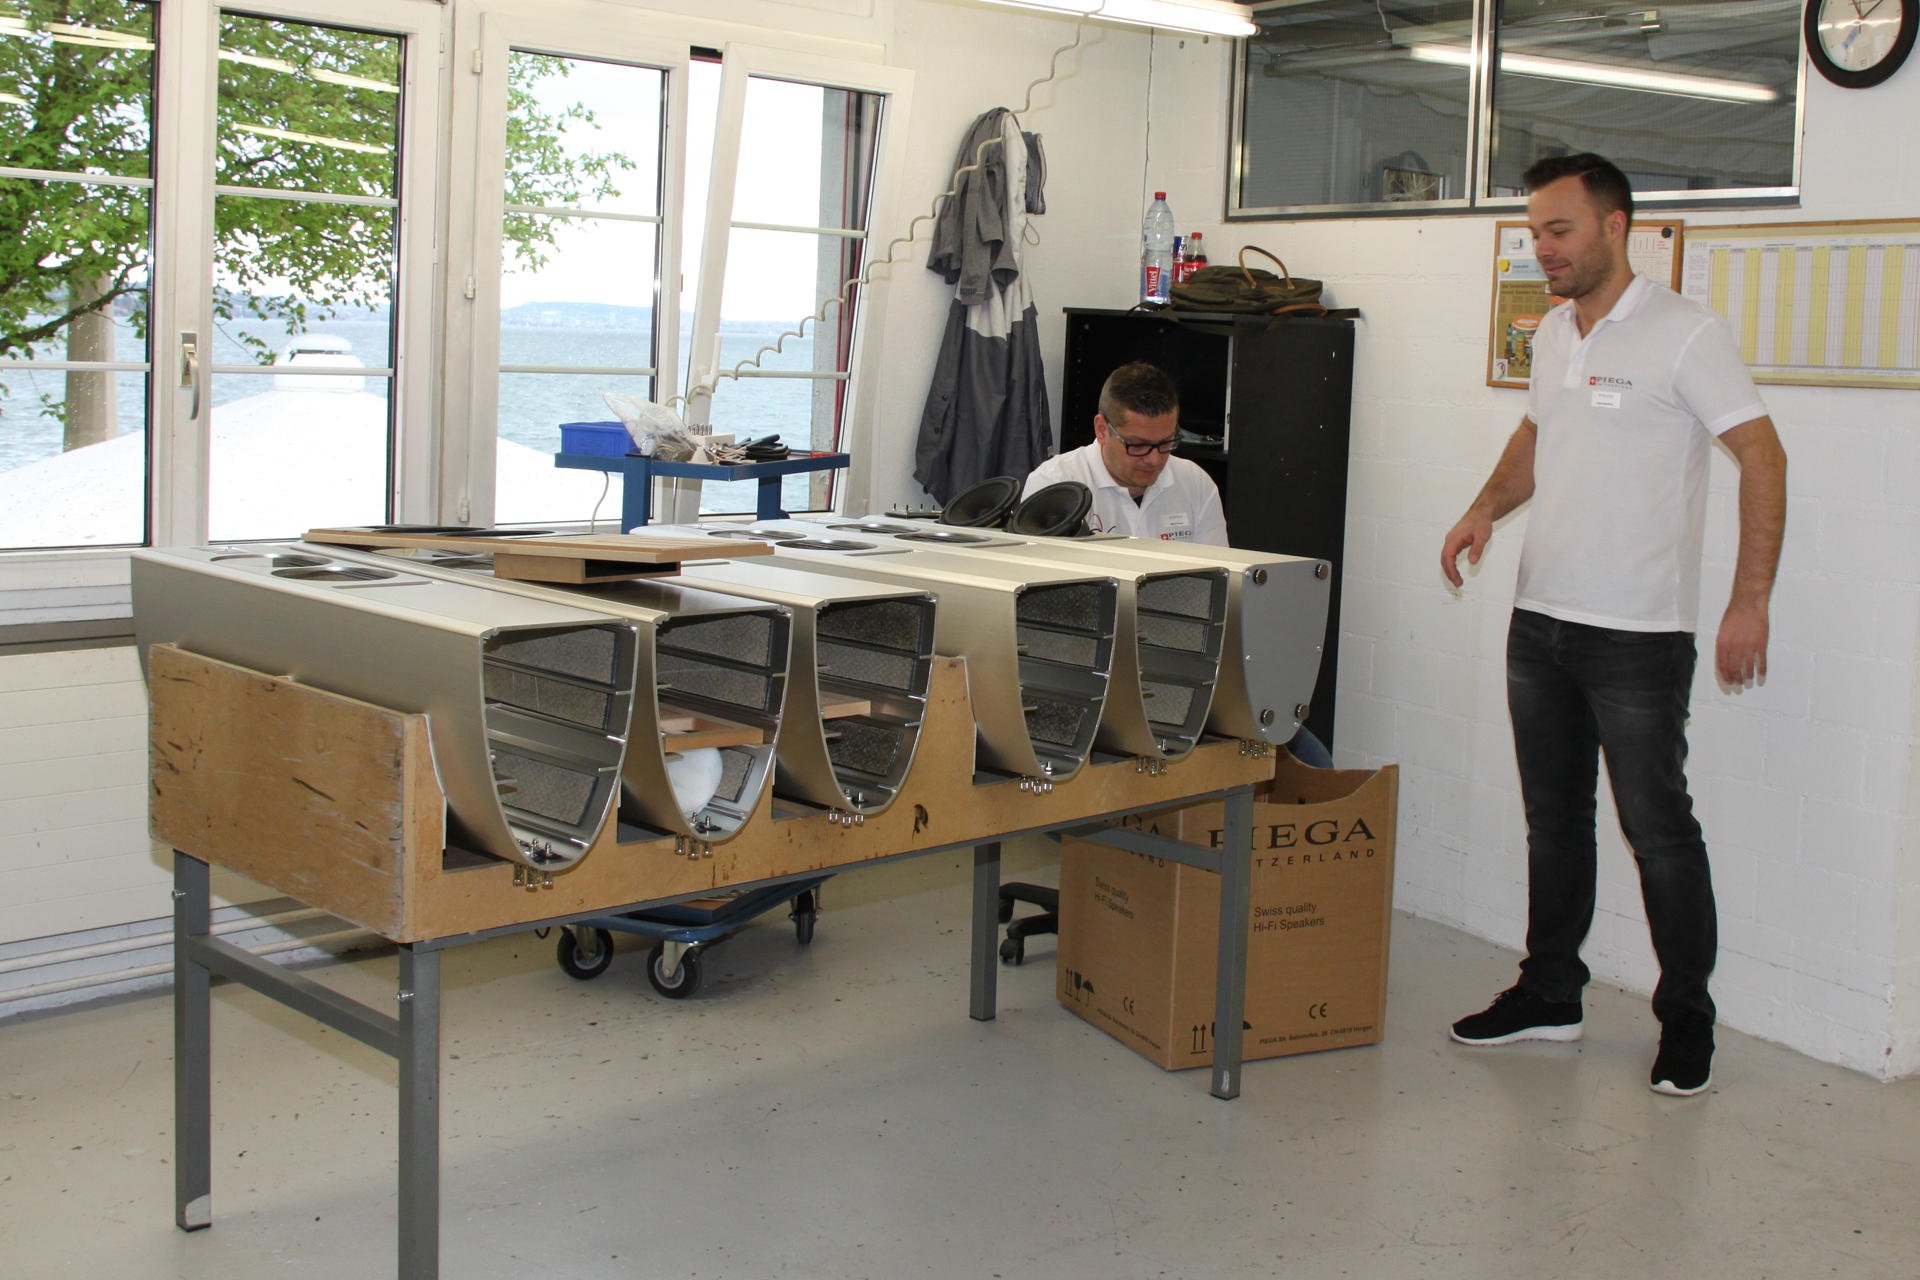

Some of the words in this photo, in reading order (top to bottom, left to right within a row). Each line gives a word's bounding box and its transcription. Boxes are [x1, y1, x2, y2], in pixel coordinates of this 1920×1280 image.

[1148, 271, 1157, 293] Vittel
[1596, 376, 1633, 386] PIEGA
[1256, 849, 1375, 868] TZERLAND
[1254, 906, 1283, 918] Swiss
[1286, 903, 1318, 917] quality
[1254, 921, 1277, 933] Hi-Fi
[1280, 918, 1325, 932] Speakers
[1309, 1003, 1328, 1019] CE
